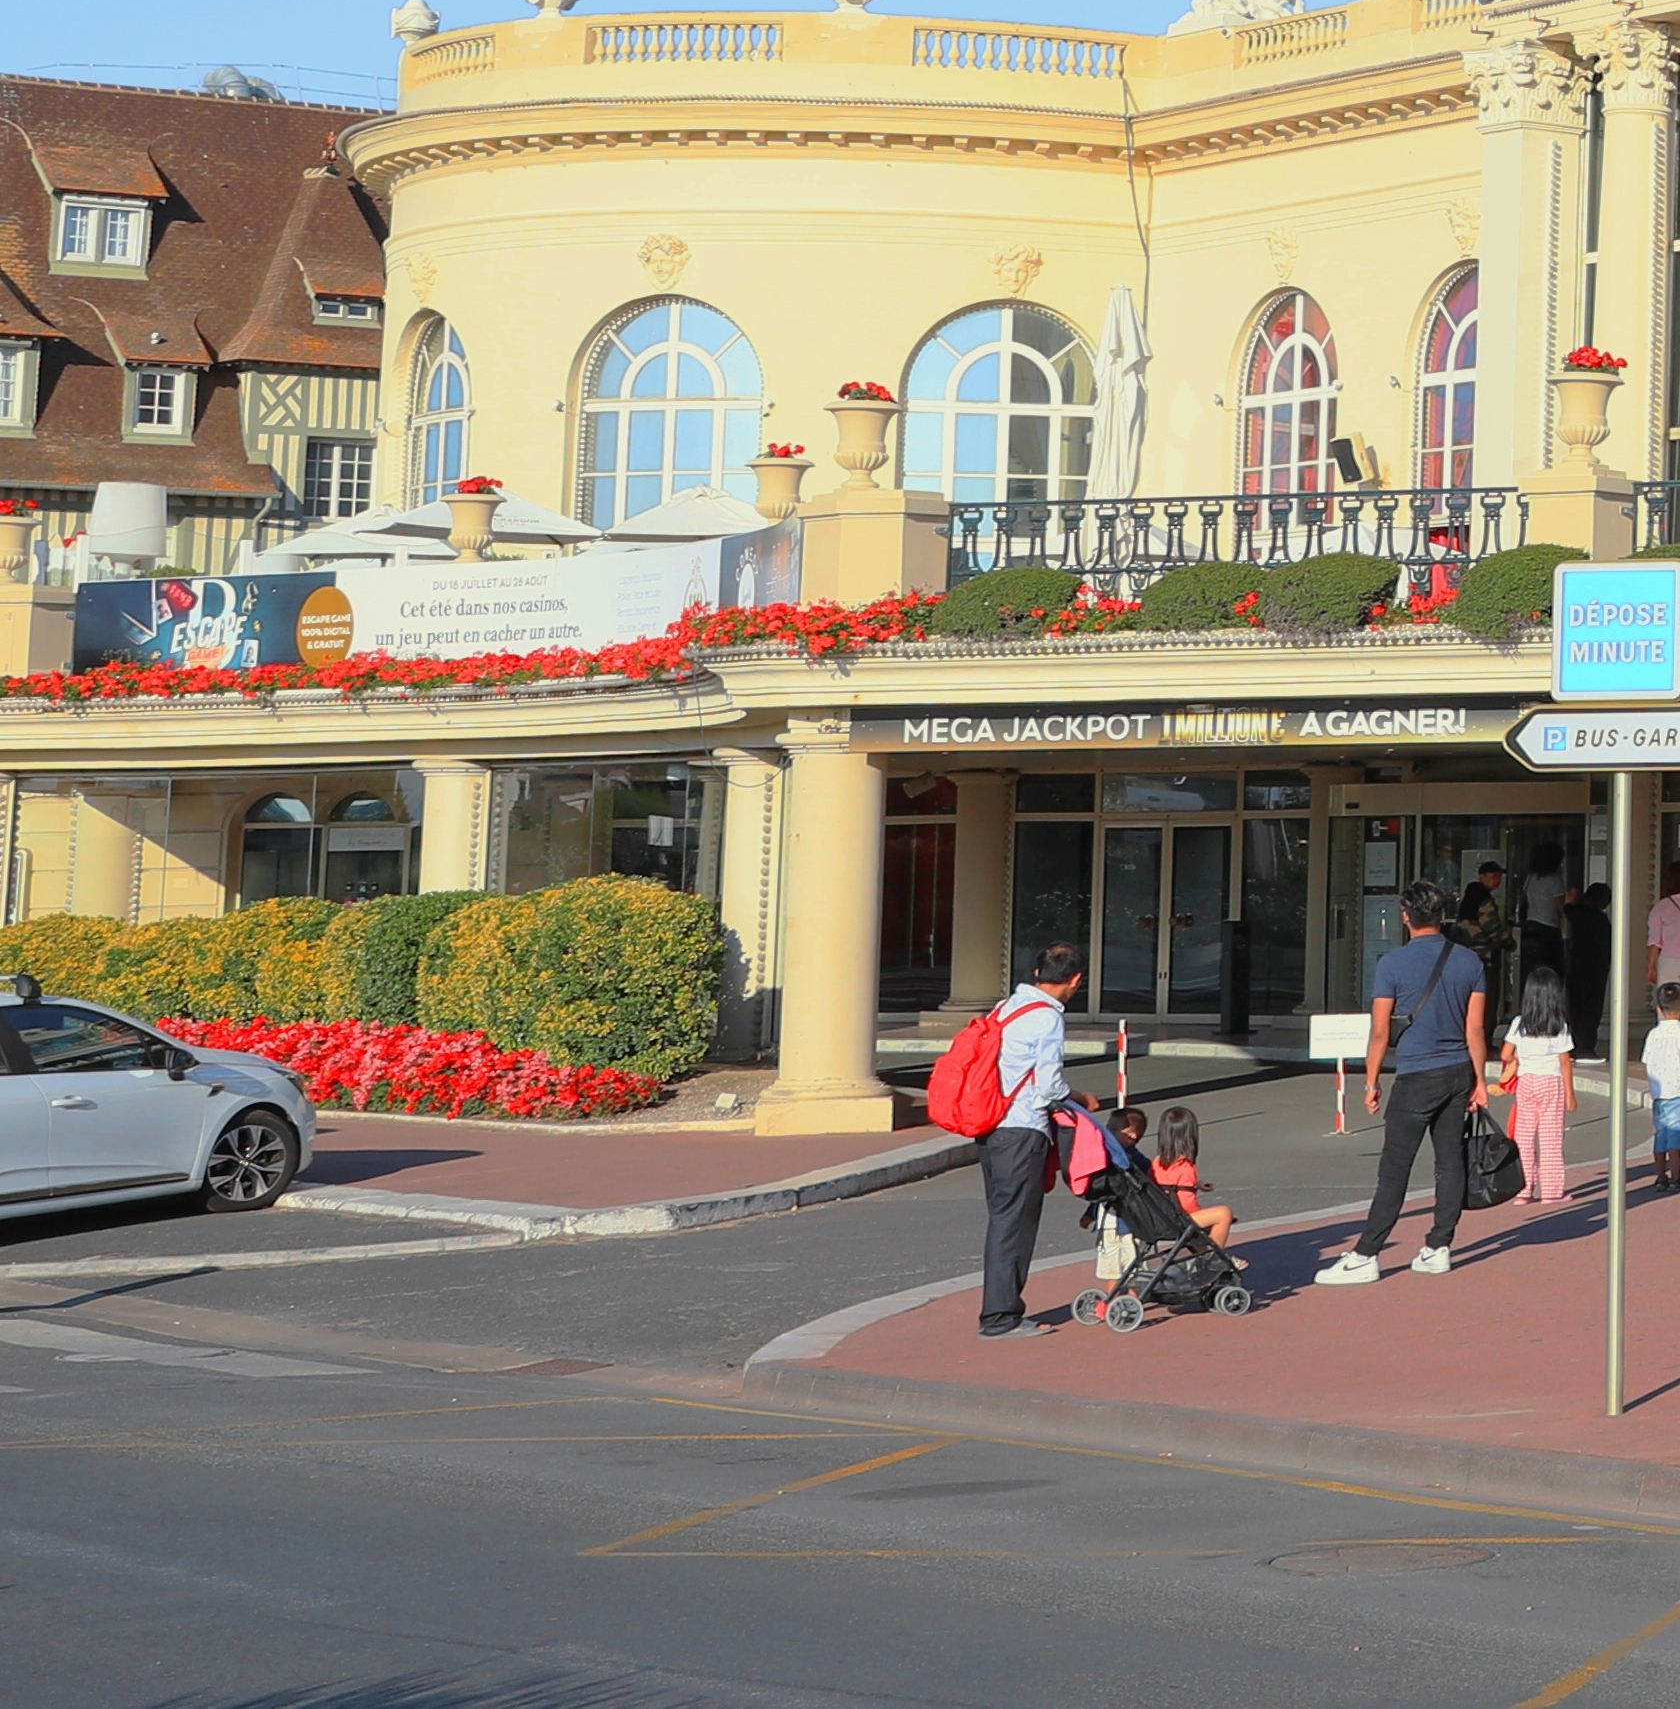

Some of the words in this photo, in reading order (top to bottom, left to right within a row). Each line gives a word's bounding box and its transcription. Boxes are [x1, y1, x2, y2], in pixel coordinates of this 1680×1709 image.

[432, 580, 447, 591] DU
[460, 577, 498, 590] JUILLET
[499, 577, 511, 588] AU
[524, 574, 548, 587] AOÛT
[400, 601, 425, 618] Cet
[429, 599, 452, 617] été
[456, 598, 490, 616] dans
[492, 599, 516, 614] nos
[519, 594, 568, 613] casinos,
[1569, 600, 1668, 627] DÉPOSE
[170, 611, 248, 653] ESCAPE
[375, 632, 394, 646] un
[399, 628, 422, 648] jeu
[426, 628, 460, 649] peut
[463, 629, 480, 642] en
[483, 624, 527, 642] cacher
[529, 626, 546, 640] un
[548, 623, 583, 639] autre.
[187, 648, 220, 660] GAME
[1569, 640, 1666, 664] MINUTE
[903, 717, 996, 744] MEGA
[1003, 714, 1151, 742] JACKPOT
[1325, 708, 1466, 738] GAGNER!
